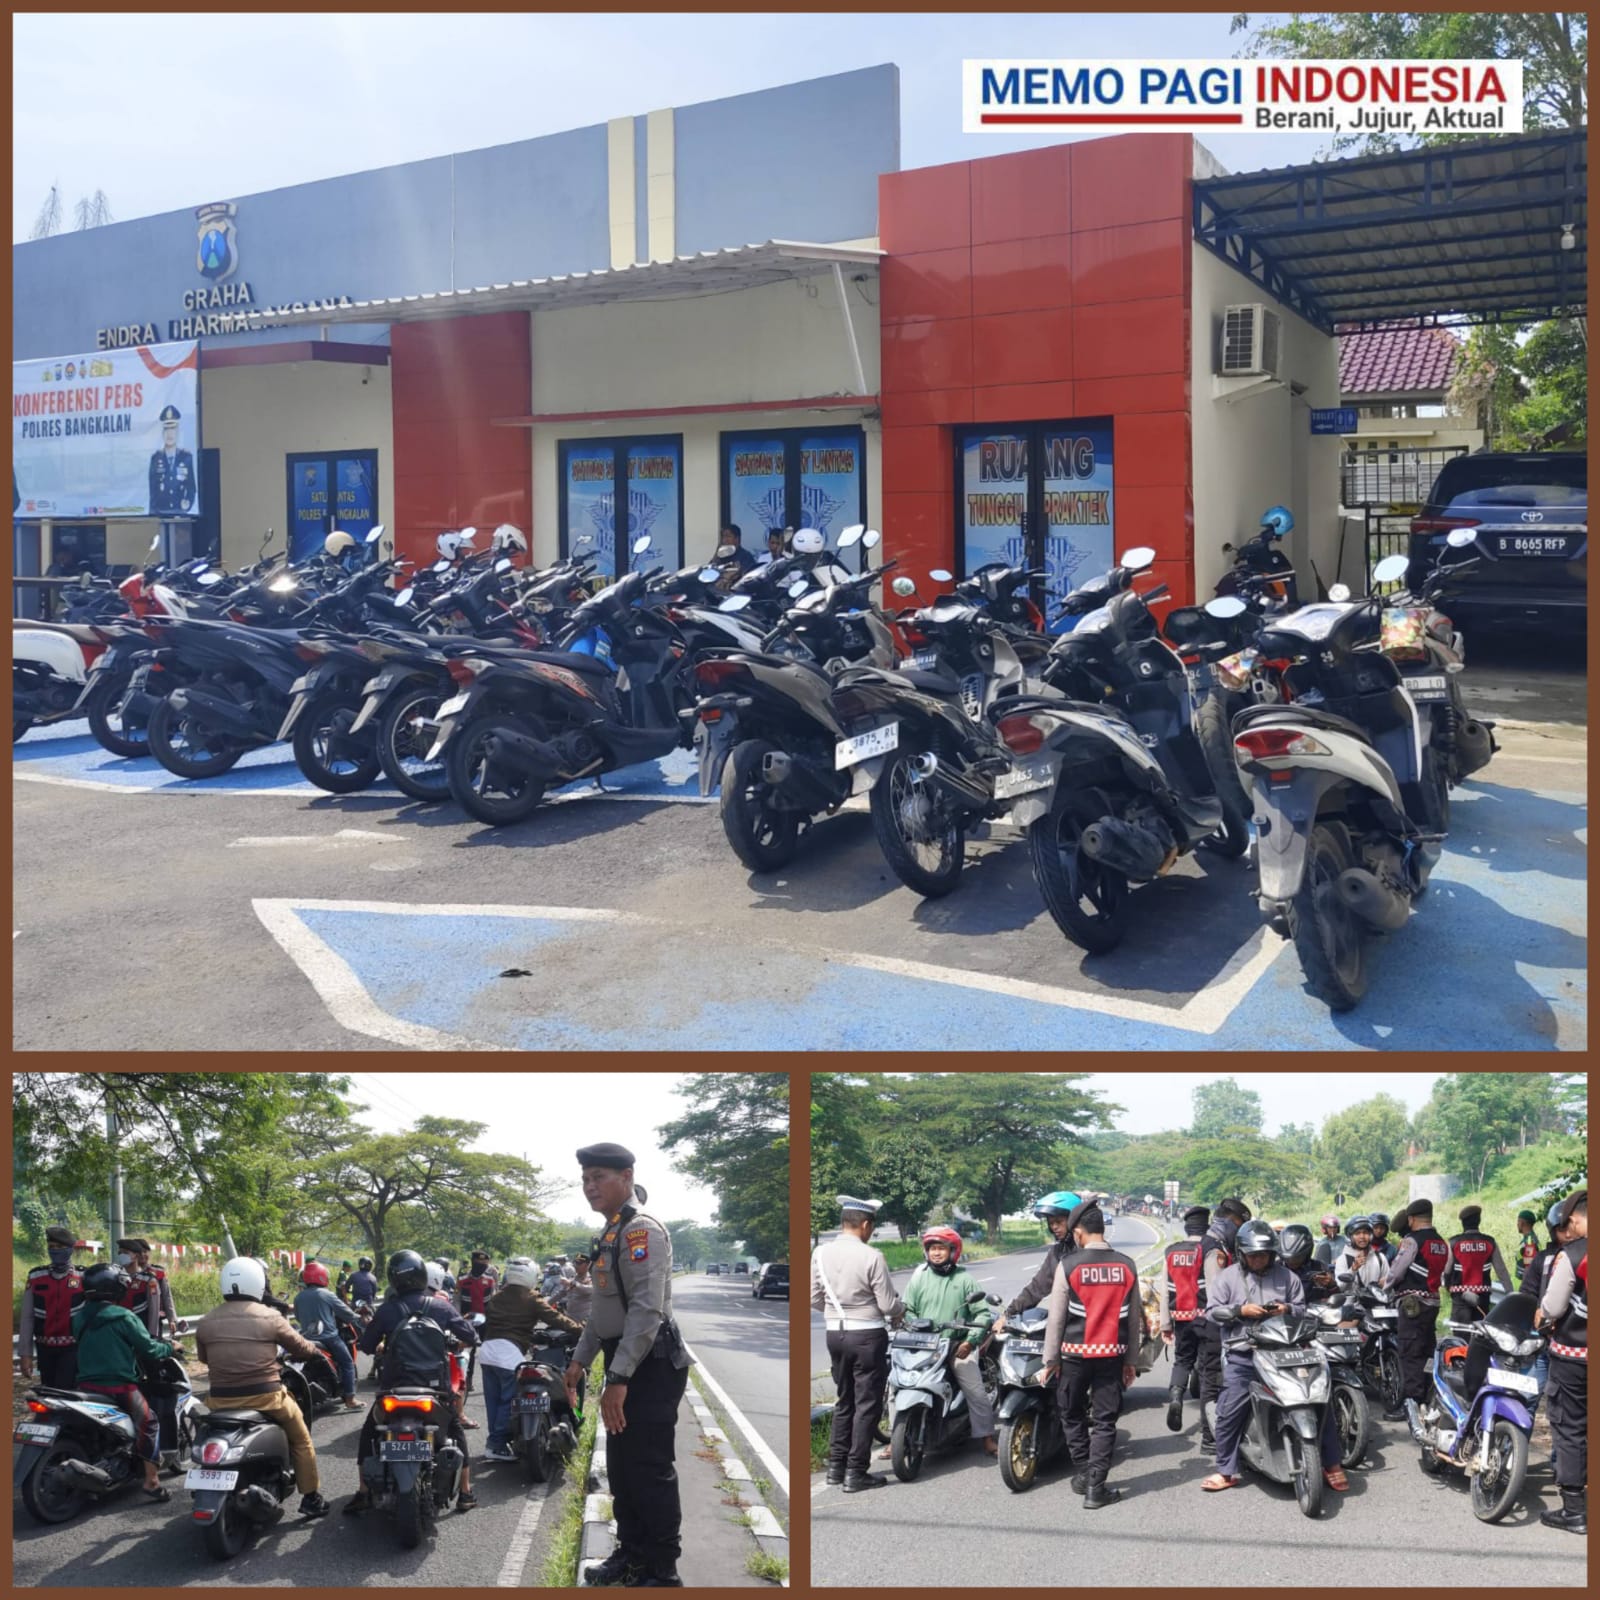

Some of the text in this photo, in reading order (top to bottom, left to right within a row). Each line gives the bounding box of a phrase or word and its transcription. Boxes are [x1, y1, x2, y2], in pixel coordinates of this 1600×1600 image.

[182, 282, 252, 311] GRAHA
[97, 323, 157, 349] ENDRA
[14, 383, 143, 416] KONFERENSI PERS
[22, 414, 131, 439] POLRES BANGKALAN
[980, 437, 1096, 482] RUANG
[968, 491, 1110, 526] TUNGGU PRAKTEK
[1500, 539, 1507, 550] B
[1515, 538, 1542, 550] 8665
[1460, 1242, 1487, 1253] POLISI
[1082, 1266, 1124, 1283] POLISI
[200, 1470, 222, 1480] 5593
